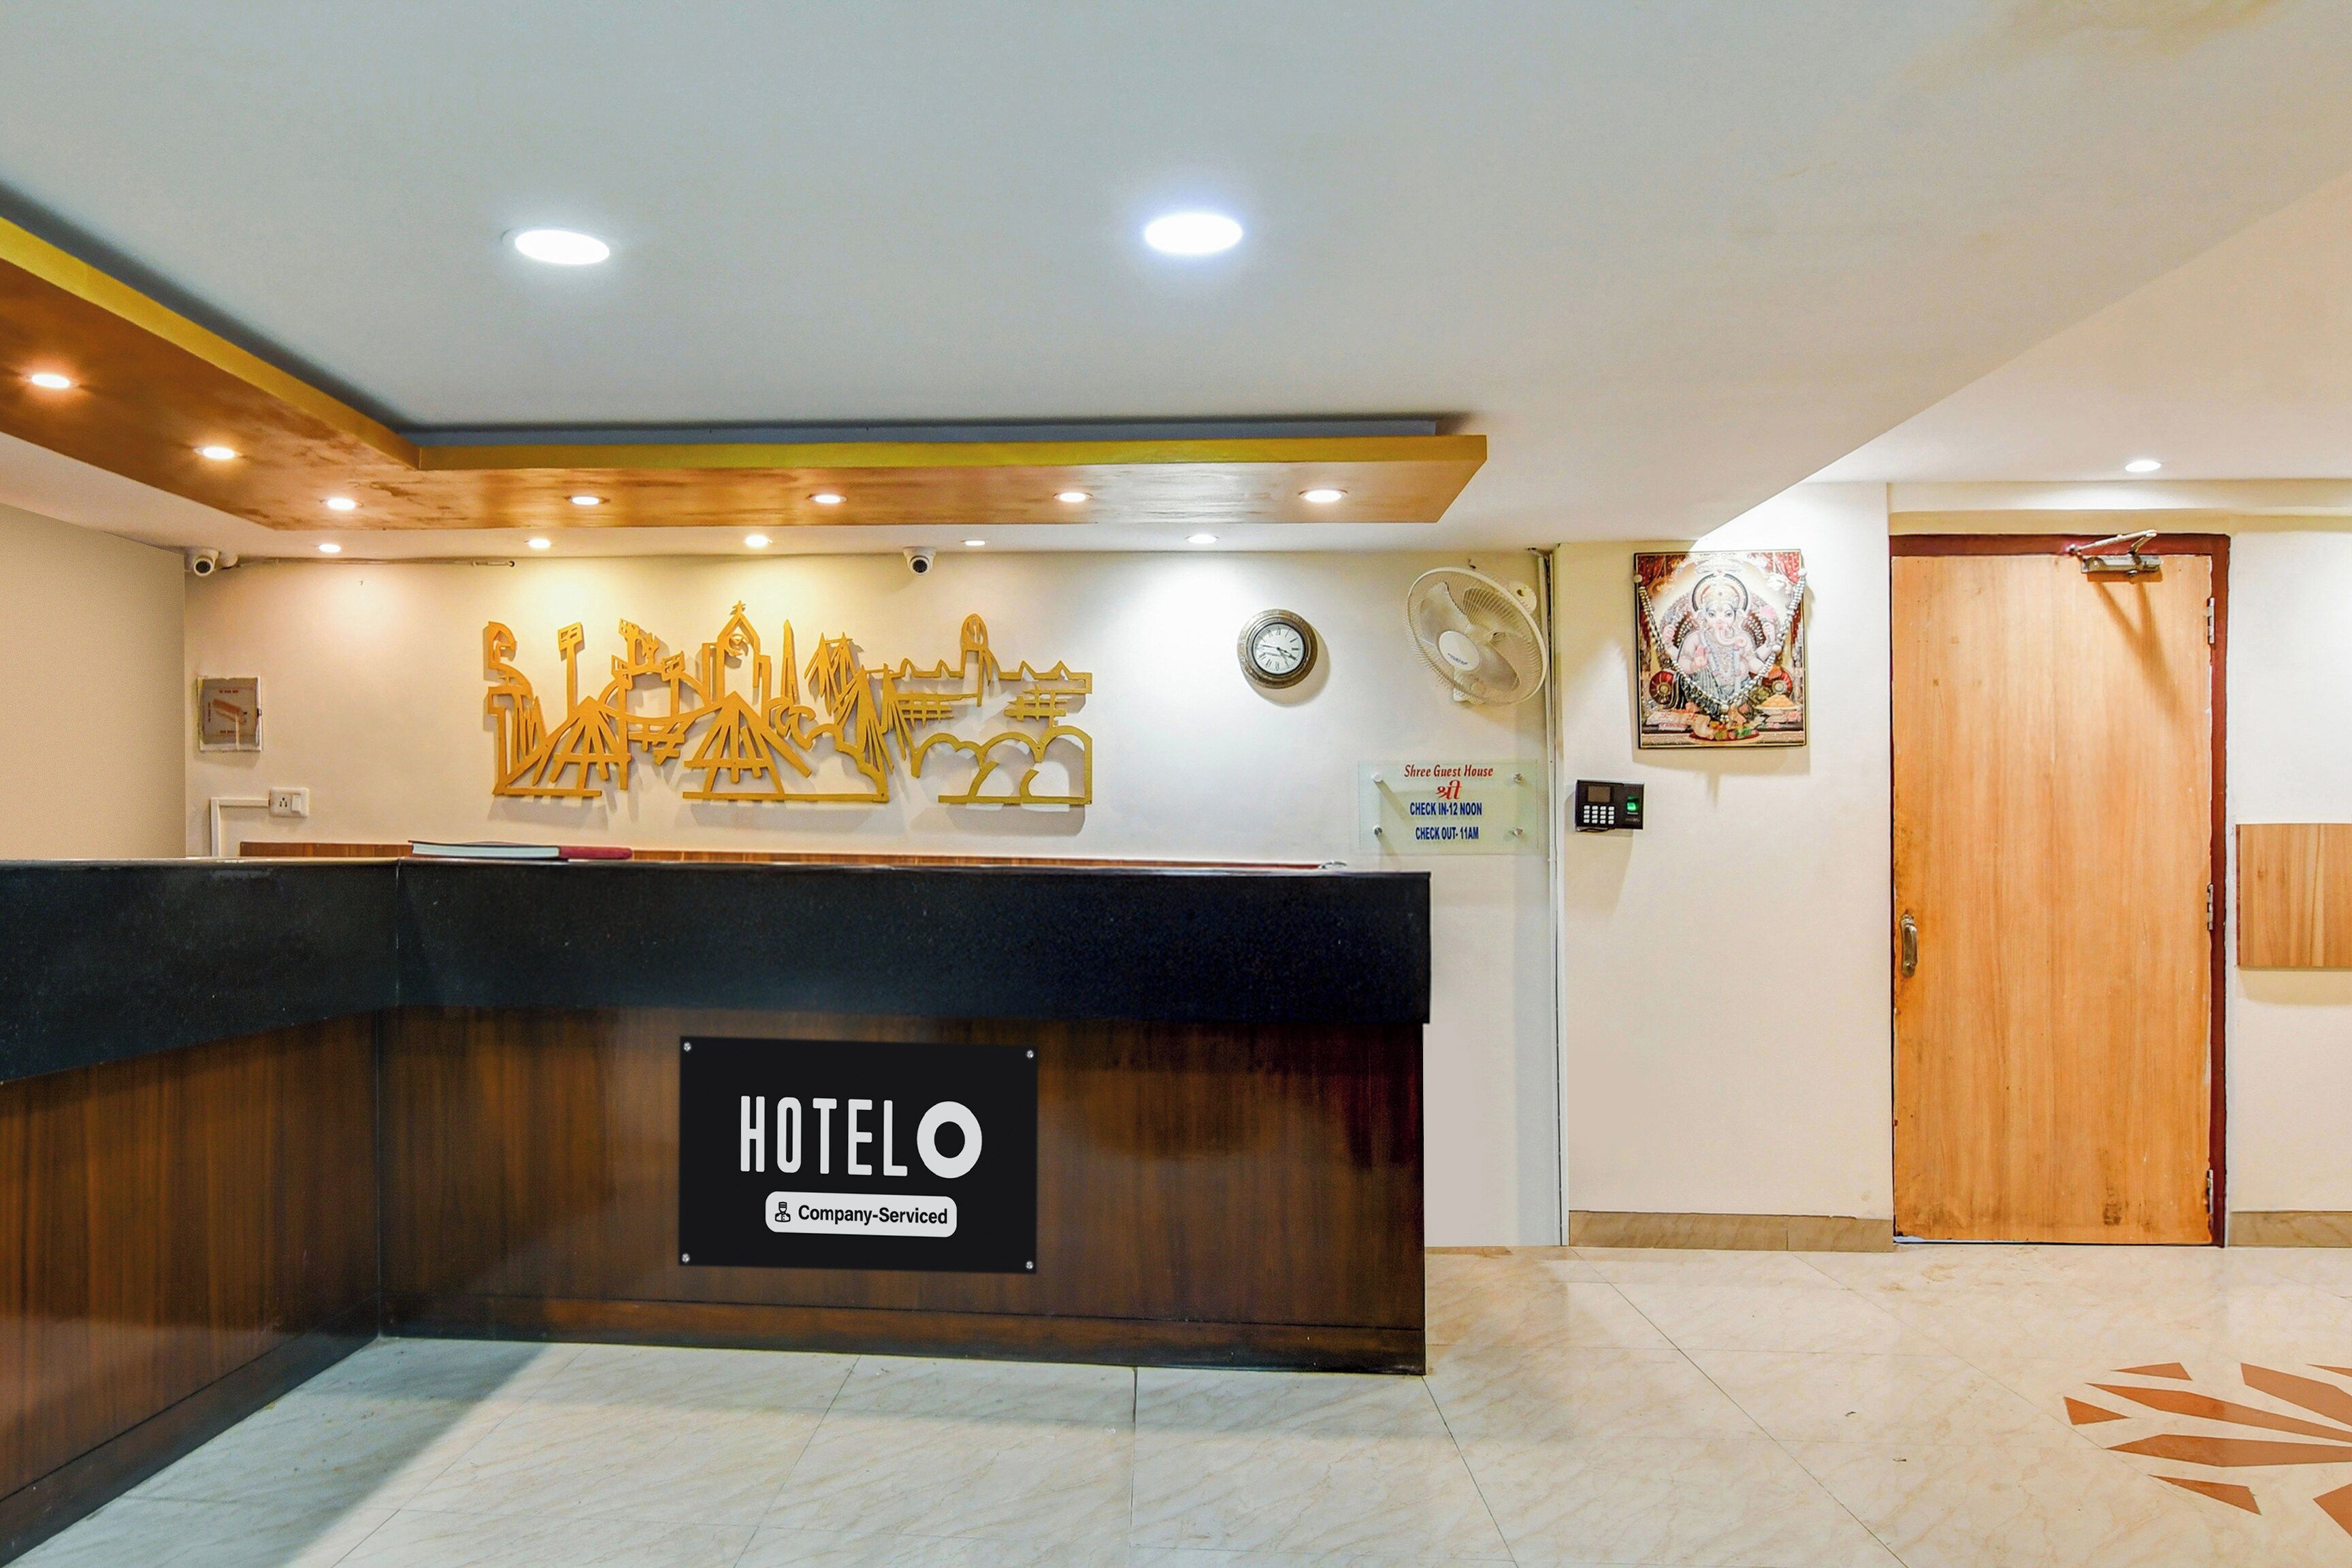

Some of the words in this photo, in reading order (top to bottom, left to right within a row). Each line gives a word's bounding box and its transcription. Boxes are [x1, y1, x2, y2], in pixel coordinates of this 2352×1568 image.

[1404, 764, 1431, 777] Shree
[1433, 764, 1461, 777] Guest
[1464, 764, 1494, 777] House
[1435, 779, 1463, 800] श्री
[1409, 802, 1436, 815] CHECK
[1460, 802, 1482, 815] NOON
[1416, 827, 1440, 840] CHECK
[1460, 827, 1480, 840] 11AM
[798, 1205, 948, 1225] Company-Serviced
